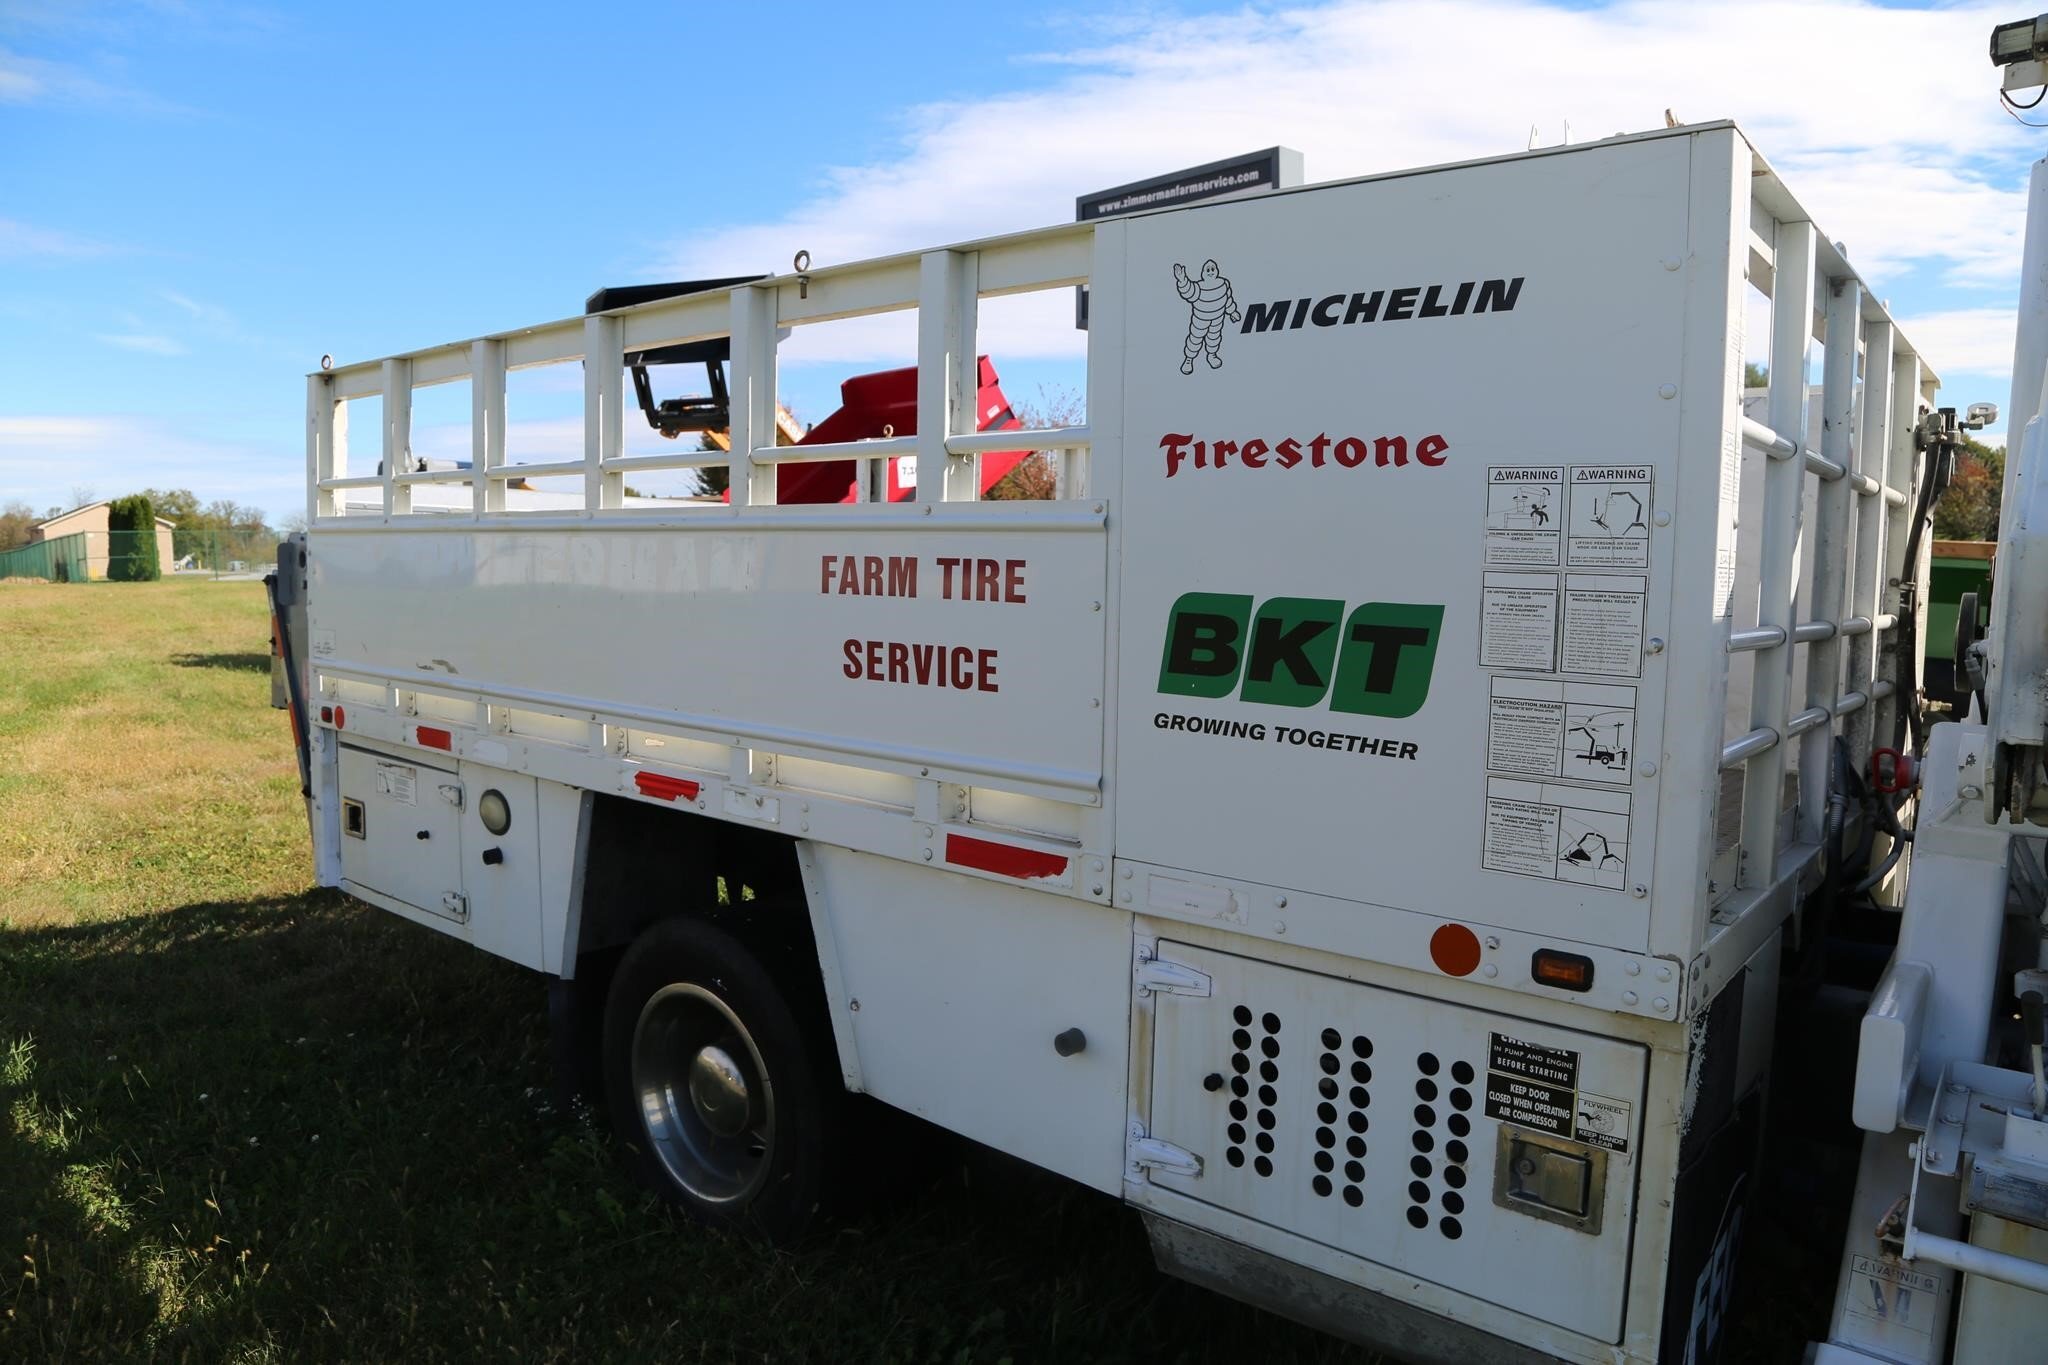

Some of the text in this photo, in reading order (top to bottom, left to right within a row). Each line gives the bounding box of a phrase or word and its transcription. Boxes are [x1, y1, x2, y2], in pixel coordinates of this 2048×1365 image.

[1098, 170, 1259, 213] www.zimmermanfarmservice.com
[1240, 277, 1525, 334] MICHELIN
[1160, 432, 1450, 478] Firestone
[1505, 470, 1558, 480] WARNING
[1588, 469, 1646, 480] WARNING
[821, 556, 1026, 603] FARM TIRE
[1167, 611, 1430, 695] BKT
[843, 638, 999, 693] SERVICE
[1153, 712, 1419, 761] GROWING TOGETHER
[1497, 1057, 1568, 1081] BEFORE STARTING
[1504, 1047, 1524, 1057] PUMP
[1527, 1054, 1543, 1062] AND
[1546, 1057, 1574, 1070] ENGINE
[1510, 1083, 1550, 1102] KEEP DOOR
[1488, 1091, 1570, 1119] CLOSED WHEN OPERATING
[1583, 1101, 1624, 1115] FLYWHEEL
[1498, 1106, 1558, 1129] AIR COMPRESSOR
[1578, 1129, 1624, 1145] KEEP HANDS
[1588, 1138, 1613, 1148] CLEAR
